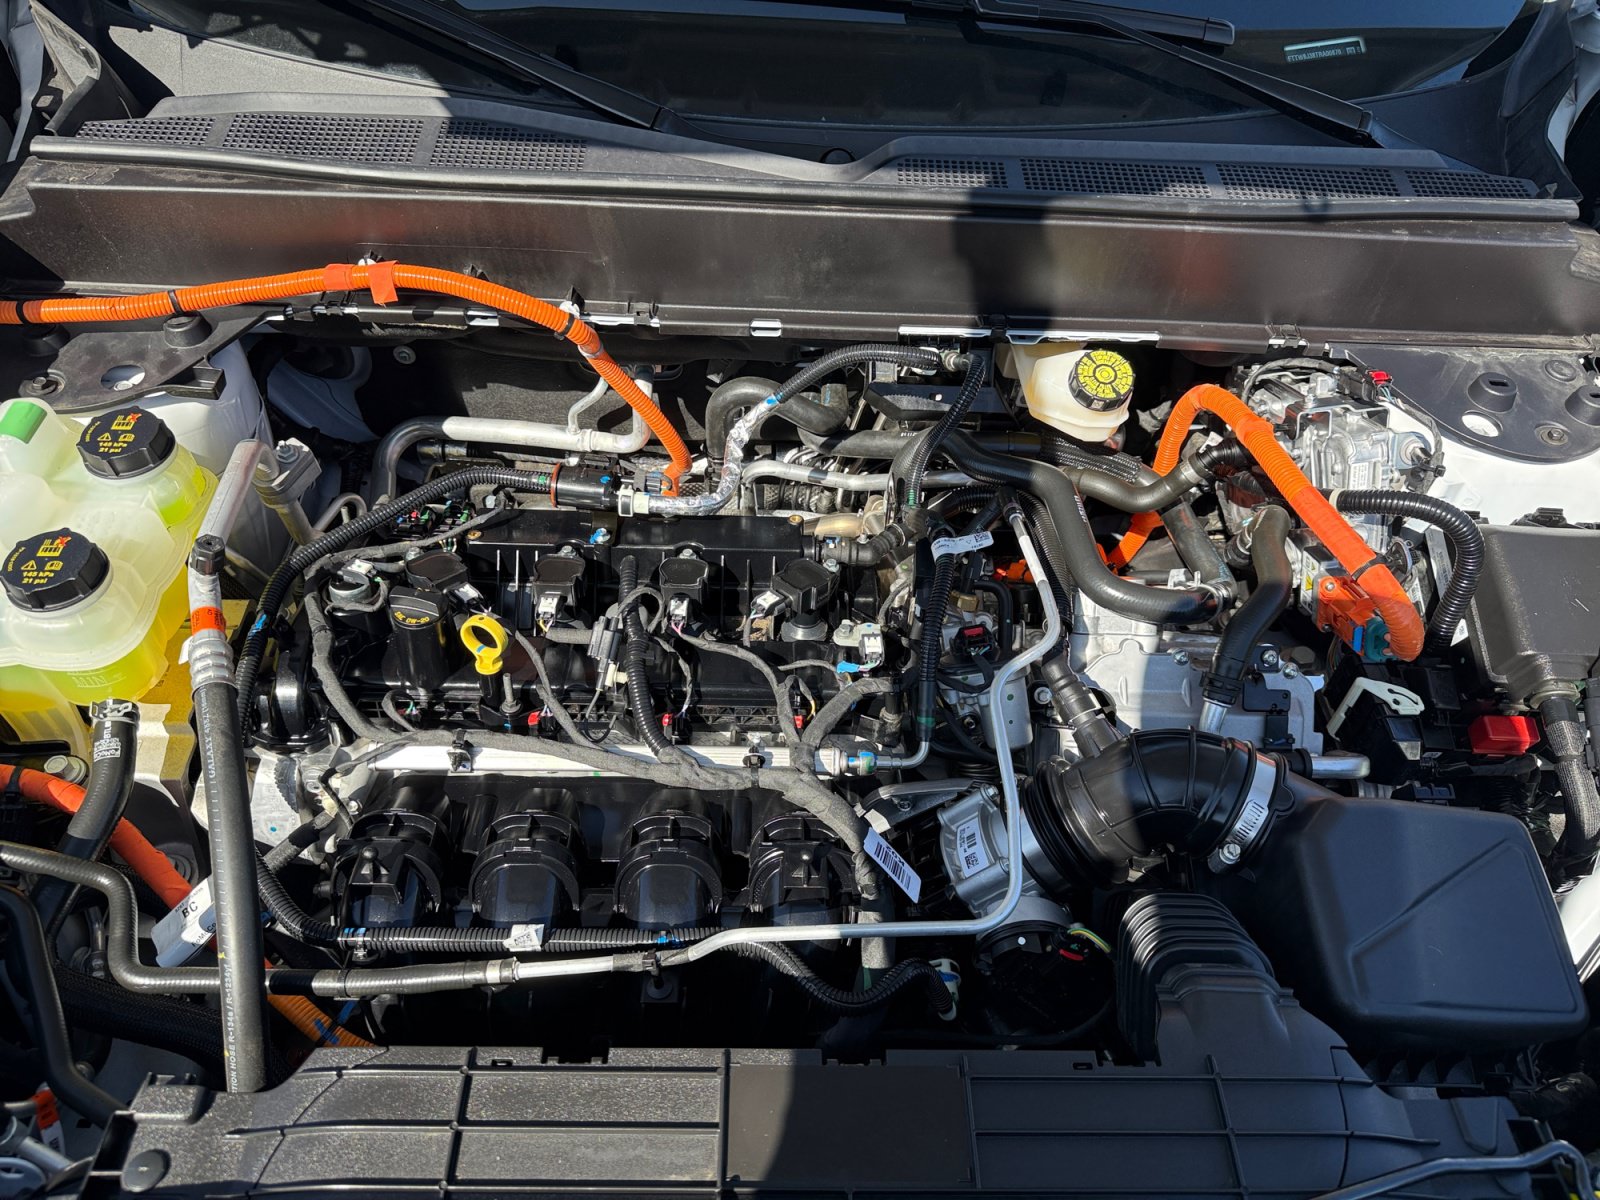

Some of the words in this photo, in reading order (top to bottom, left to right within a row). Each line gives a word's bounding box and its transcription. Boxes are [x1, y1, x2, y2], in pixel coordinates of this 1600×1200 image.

[204, 735, 217, 779] GALAXY
[181, 901, 199, 918] BC
[223, 963, 233, 1005] R-1234yf
[225, 1011, 236, 1043] R-134a
[227, 1044, 237, 1070] HOSE
